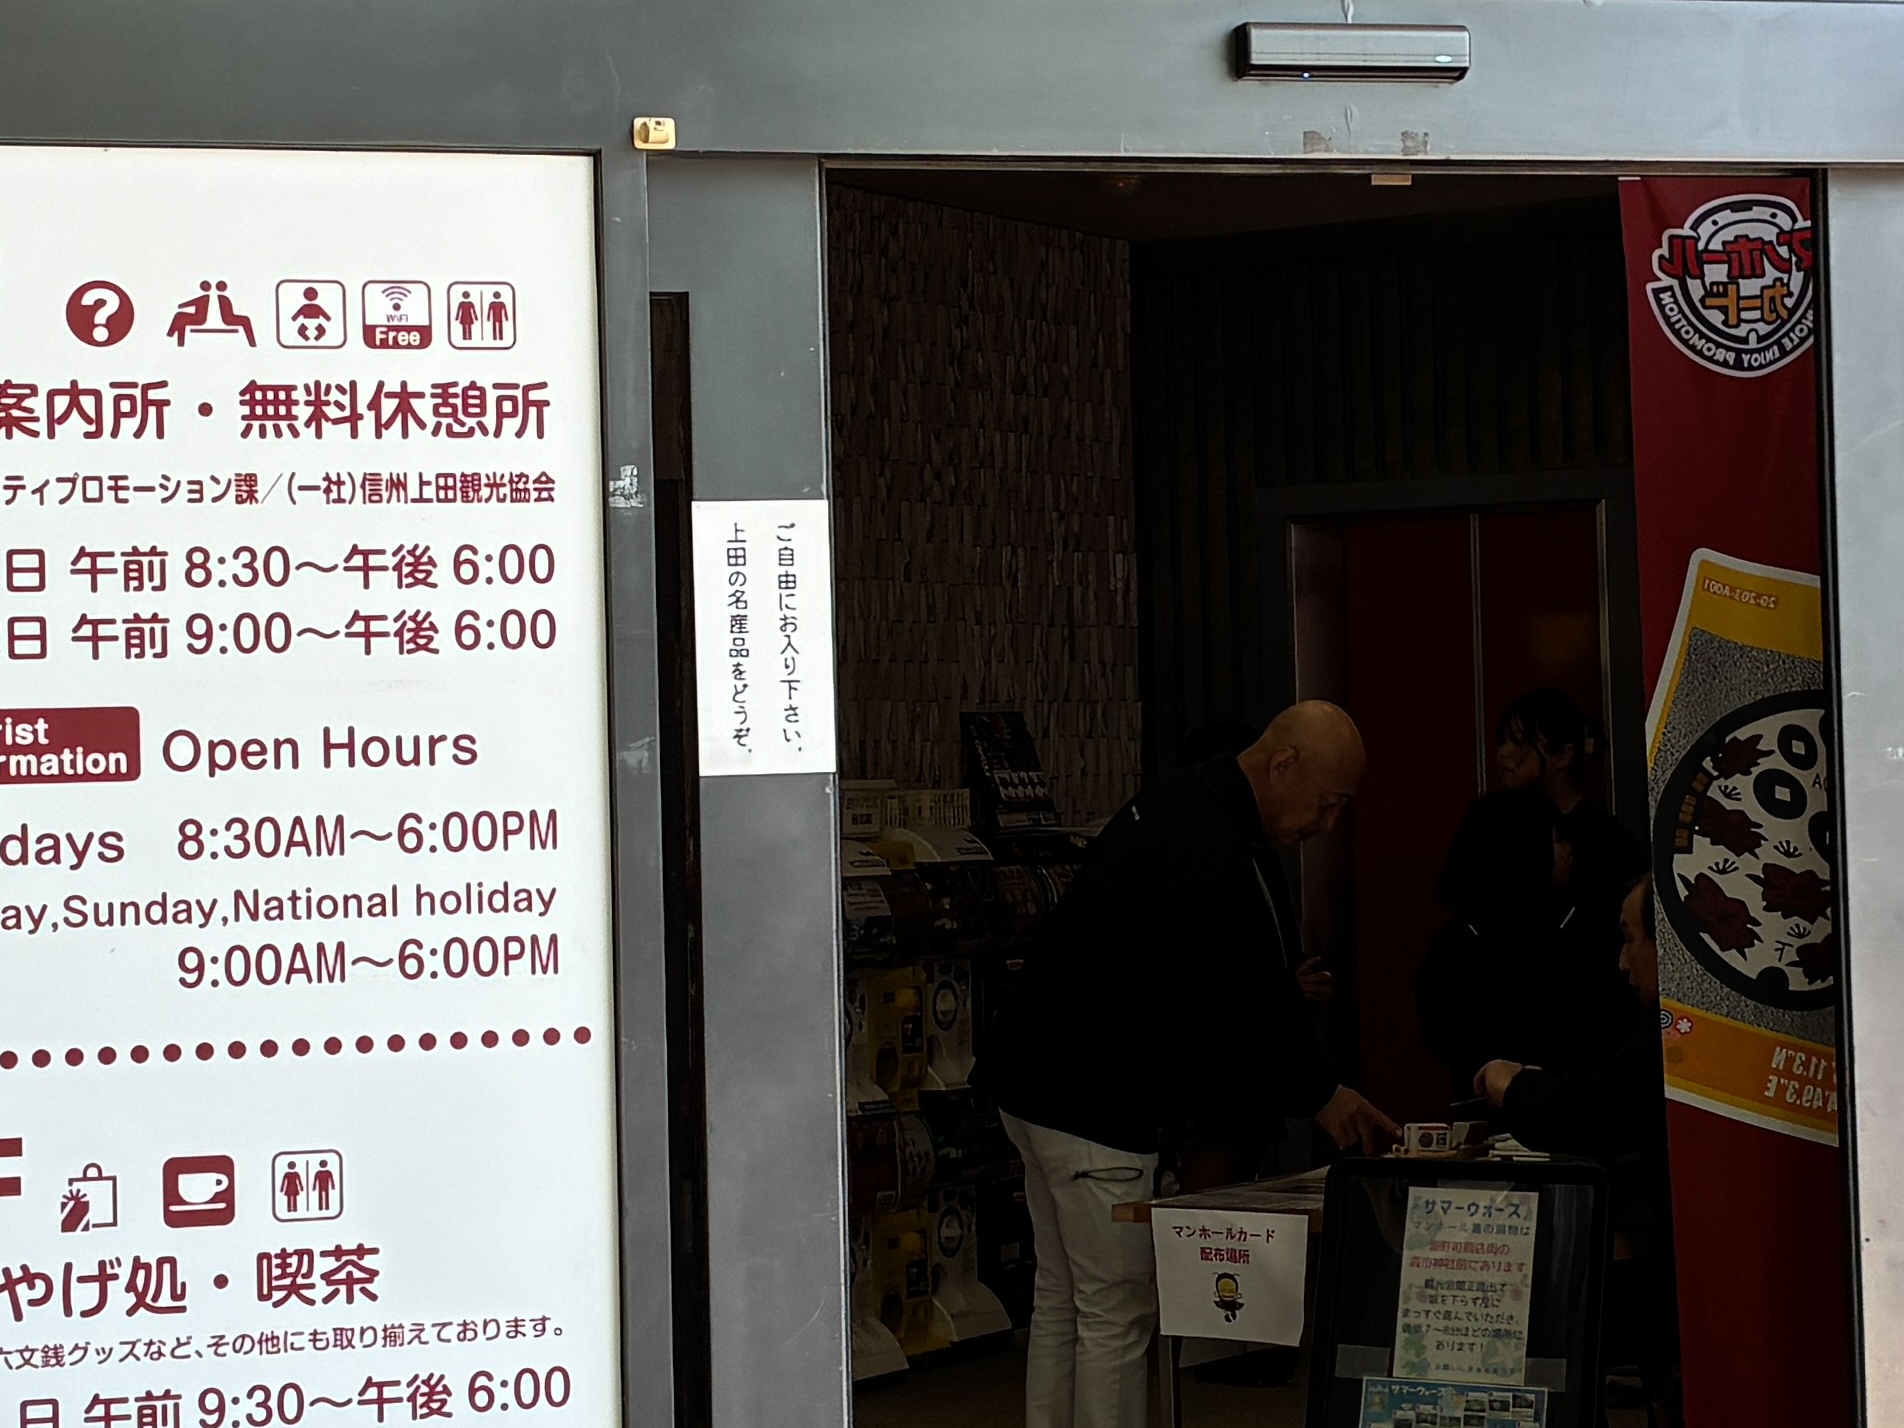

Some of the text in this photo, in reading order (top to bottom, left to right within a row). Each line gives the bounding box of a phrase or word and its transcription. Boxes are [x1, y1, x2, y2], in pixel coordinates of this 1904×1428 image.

[374, 327, 422, 346] Free
[162, 726, 479, 775] Open Hours
[416, 881, 557, 922] holiday
[1172, 1225, 1276, 1244] マンホールカード
